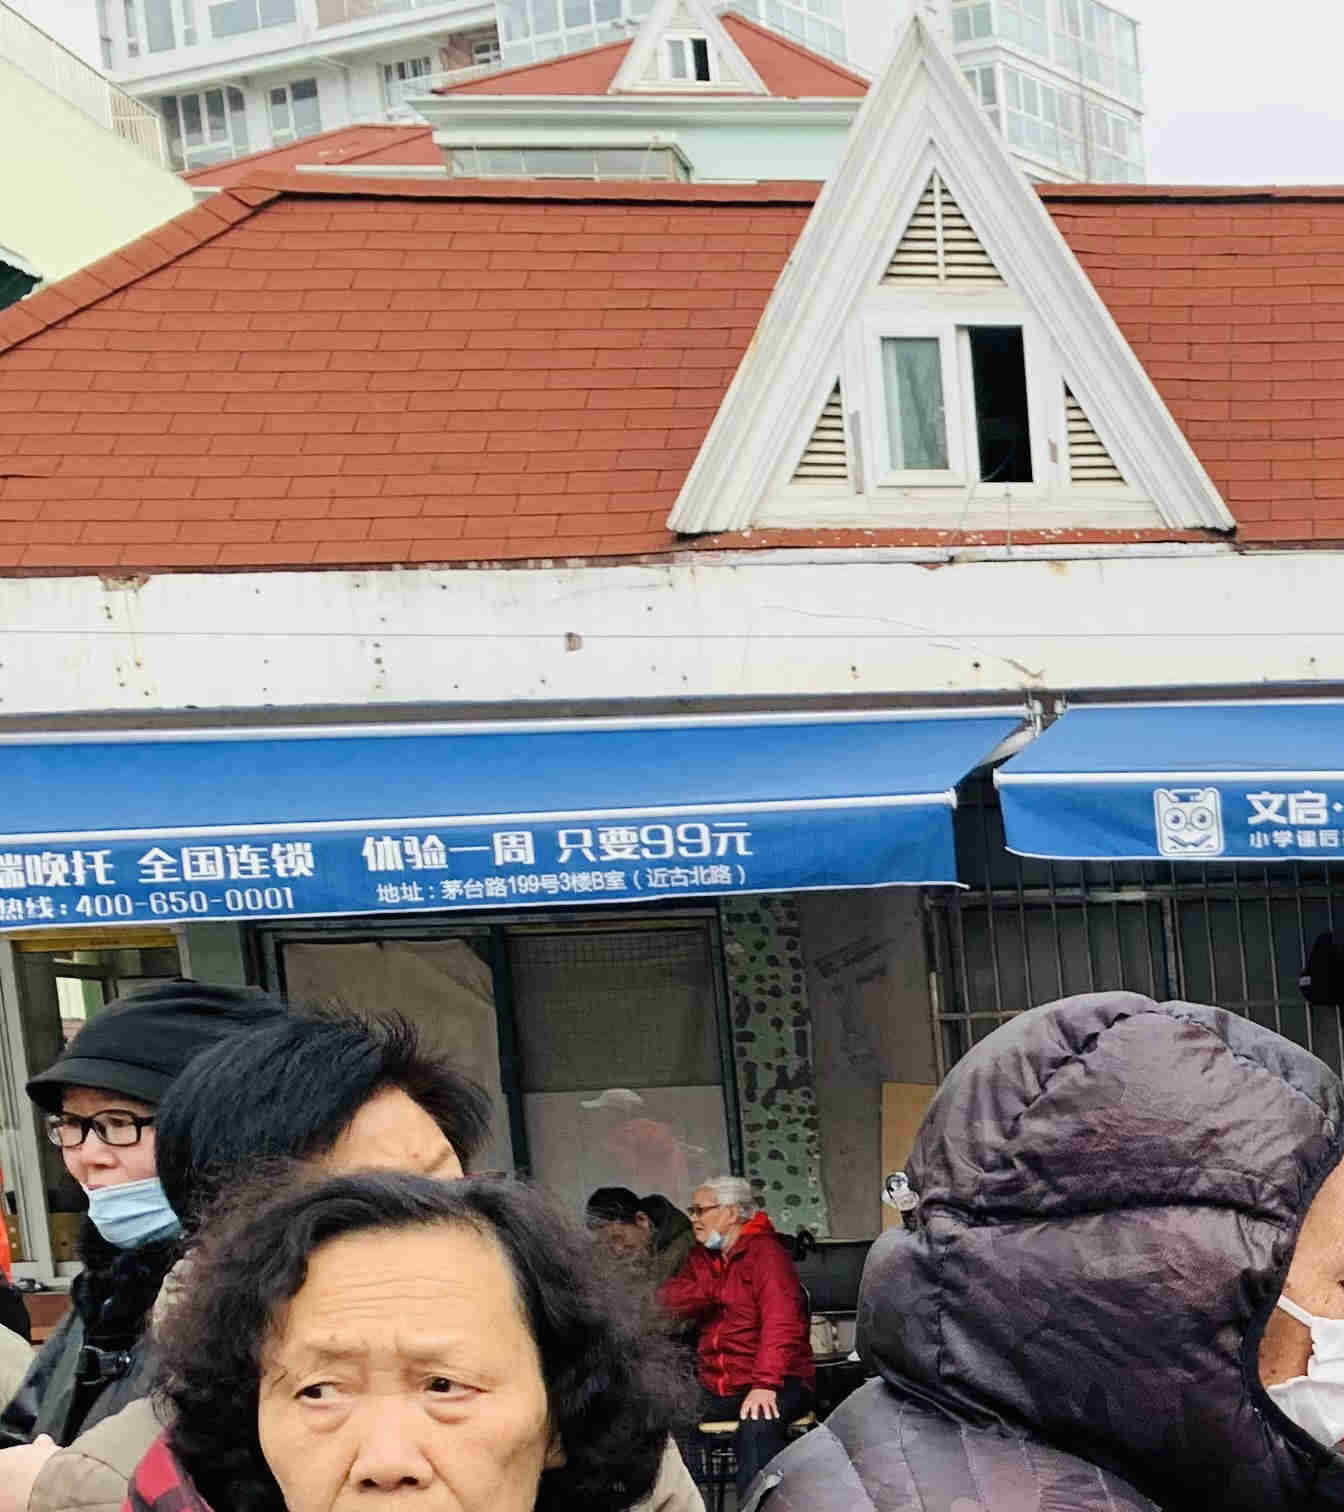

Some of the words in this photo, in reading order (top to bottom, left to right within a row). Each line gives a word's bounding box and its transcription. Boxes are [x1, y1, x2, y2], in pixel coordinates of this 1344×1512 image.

[137, 842, 315, 884] 全国连锁
[361, 831, 536, 872] 体验一周
[557, 822, 753, 864] 只要99元
